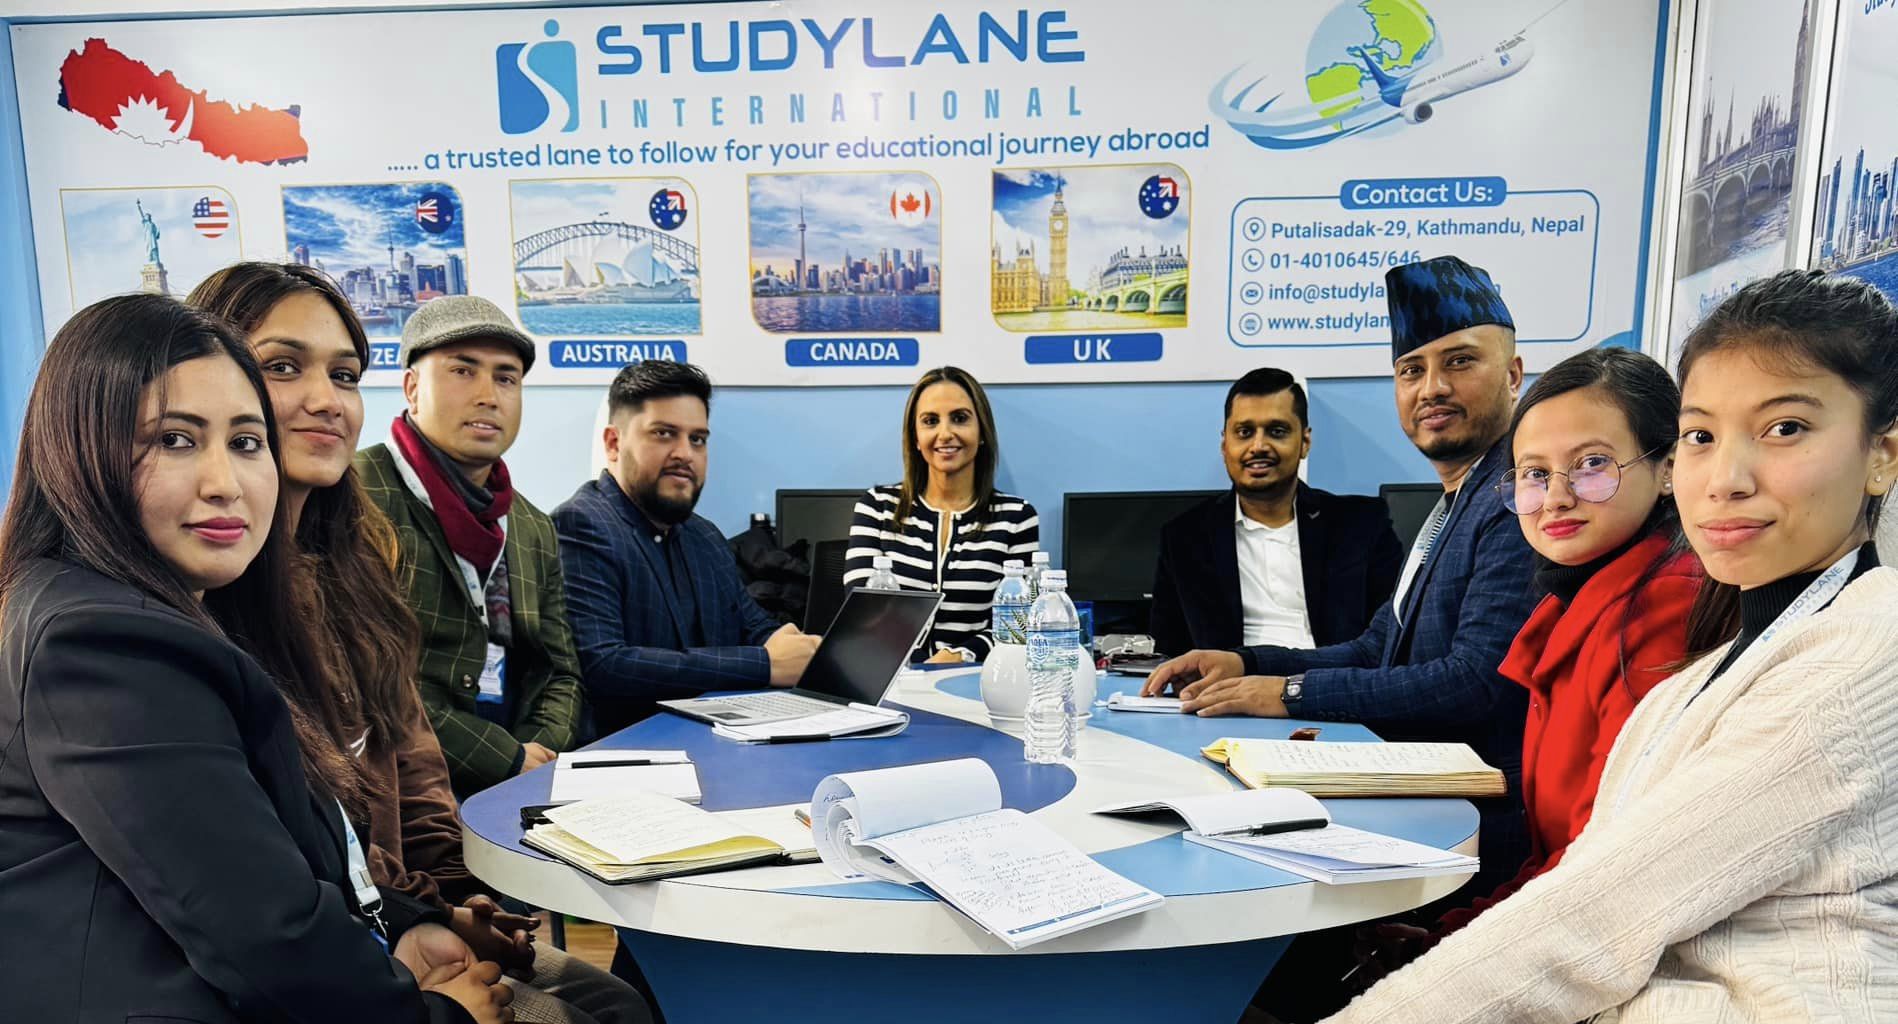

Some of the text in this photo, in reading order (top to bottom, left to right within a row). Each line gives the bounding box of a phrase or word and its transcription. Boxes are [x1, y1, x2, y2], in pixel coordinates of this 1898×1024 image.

[597, 9, 1086, 76] STUDYLANE
[600, 85, 1083, 130] INTERNATIONAL
[424, 153, 440, 170] a
[446, 144, 540, 169] trusted
[547, 143, 601, 166] lane
[607, 144, 634, 164] to
[640, 140, 717, 164] follow
[724, 139, 763, 162] for
[769, 138, 829, 166] your
[836, 132, 992, 159] educational
[997, 133, 1102, 164] journey
[1108, 125, 1210, 151] abroad
[1352, 181, 1494, 205] Contact Us:
[1271, 214, 1585, 239] Putalisadak-29, Kathmandu, Nepal
[1270, 250, 1421, 269] 01-4010645/646
[561, 344, 676, 363] AUSTRALIA
[810, 342, 900, 361] CANADA
[1074, 339, 1112, 361] UK
